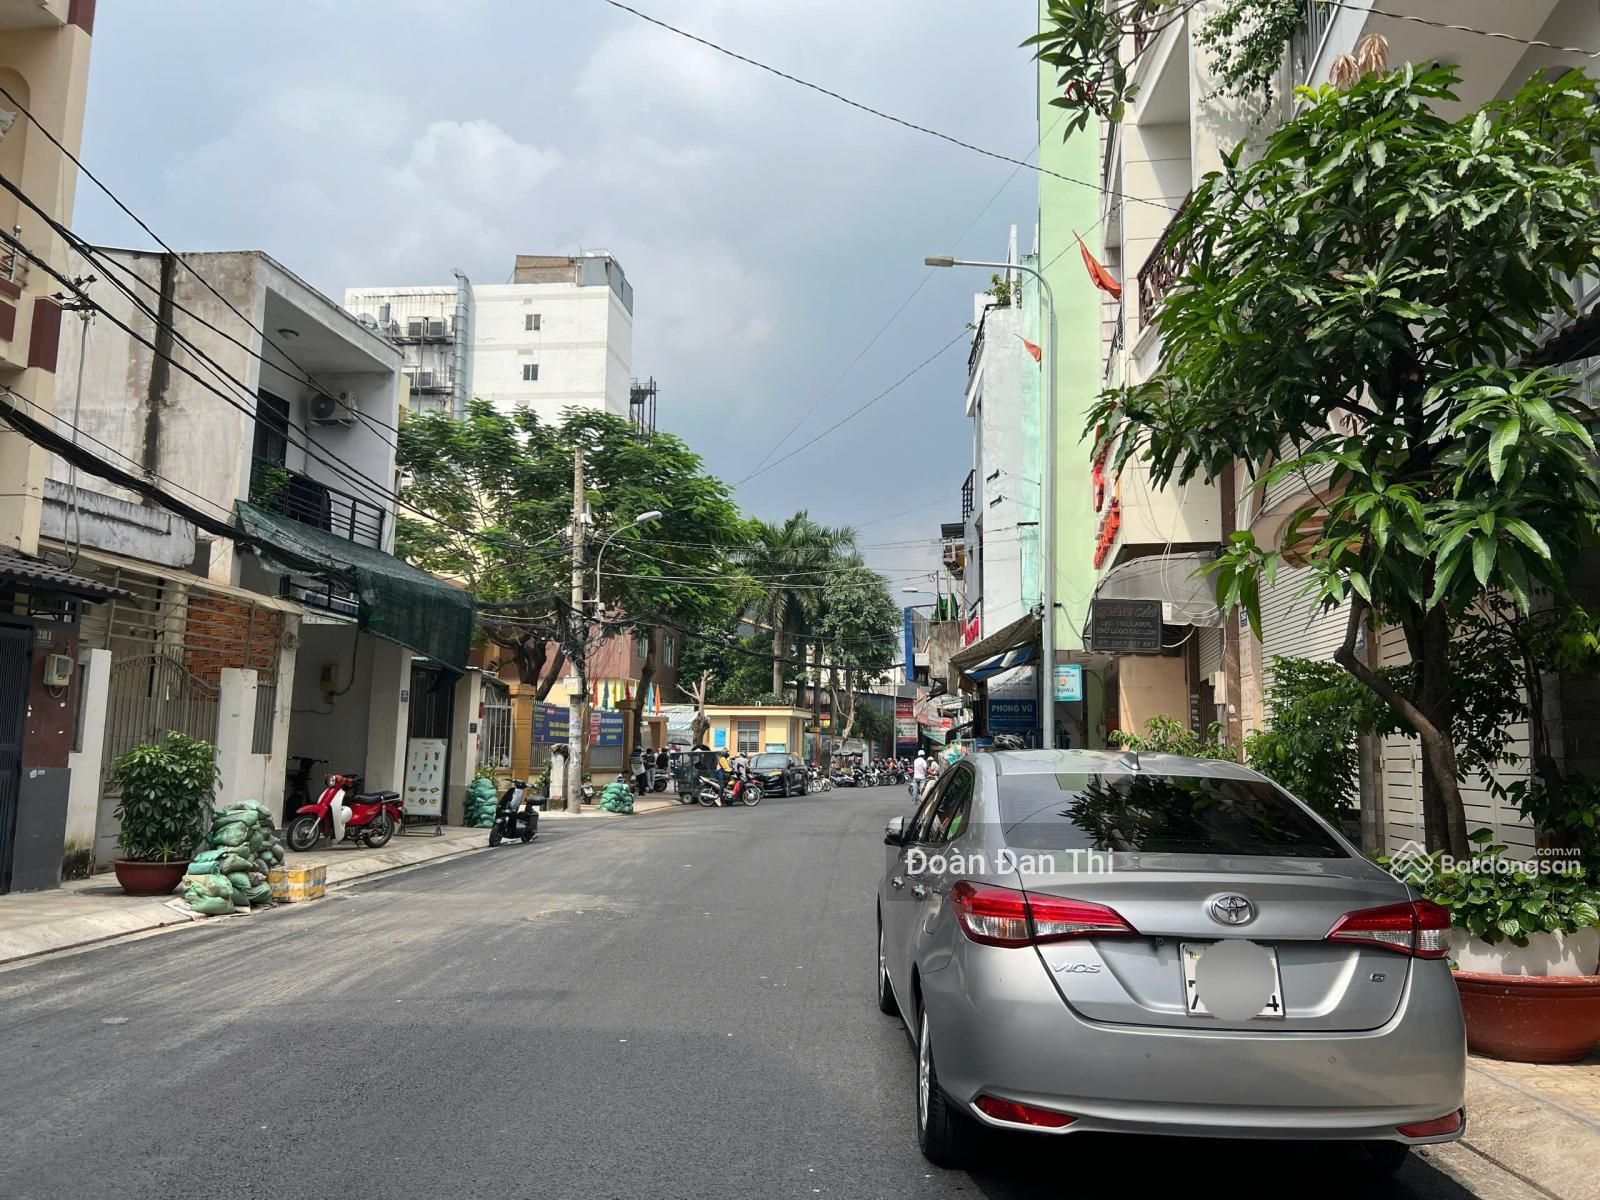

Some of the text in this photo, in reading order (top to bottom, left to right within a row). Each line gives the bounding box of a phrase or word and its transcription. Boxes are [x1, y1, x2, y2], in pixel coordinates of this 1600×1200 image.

[991, 703, 1033, 712] PHONG VŨ
[1052, 964, 1102, 973] VIOS
